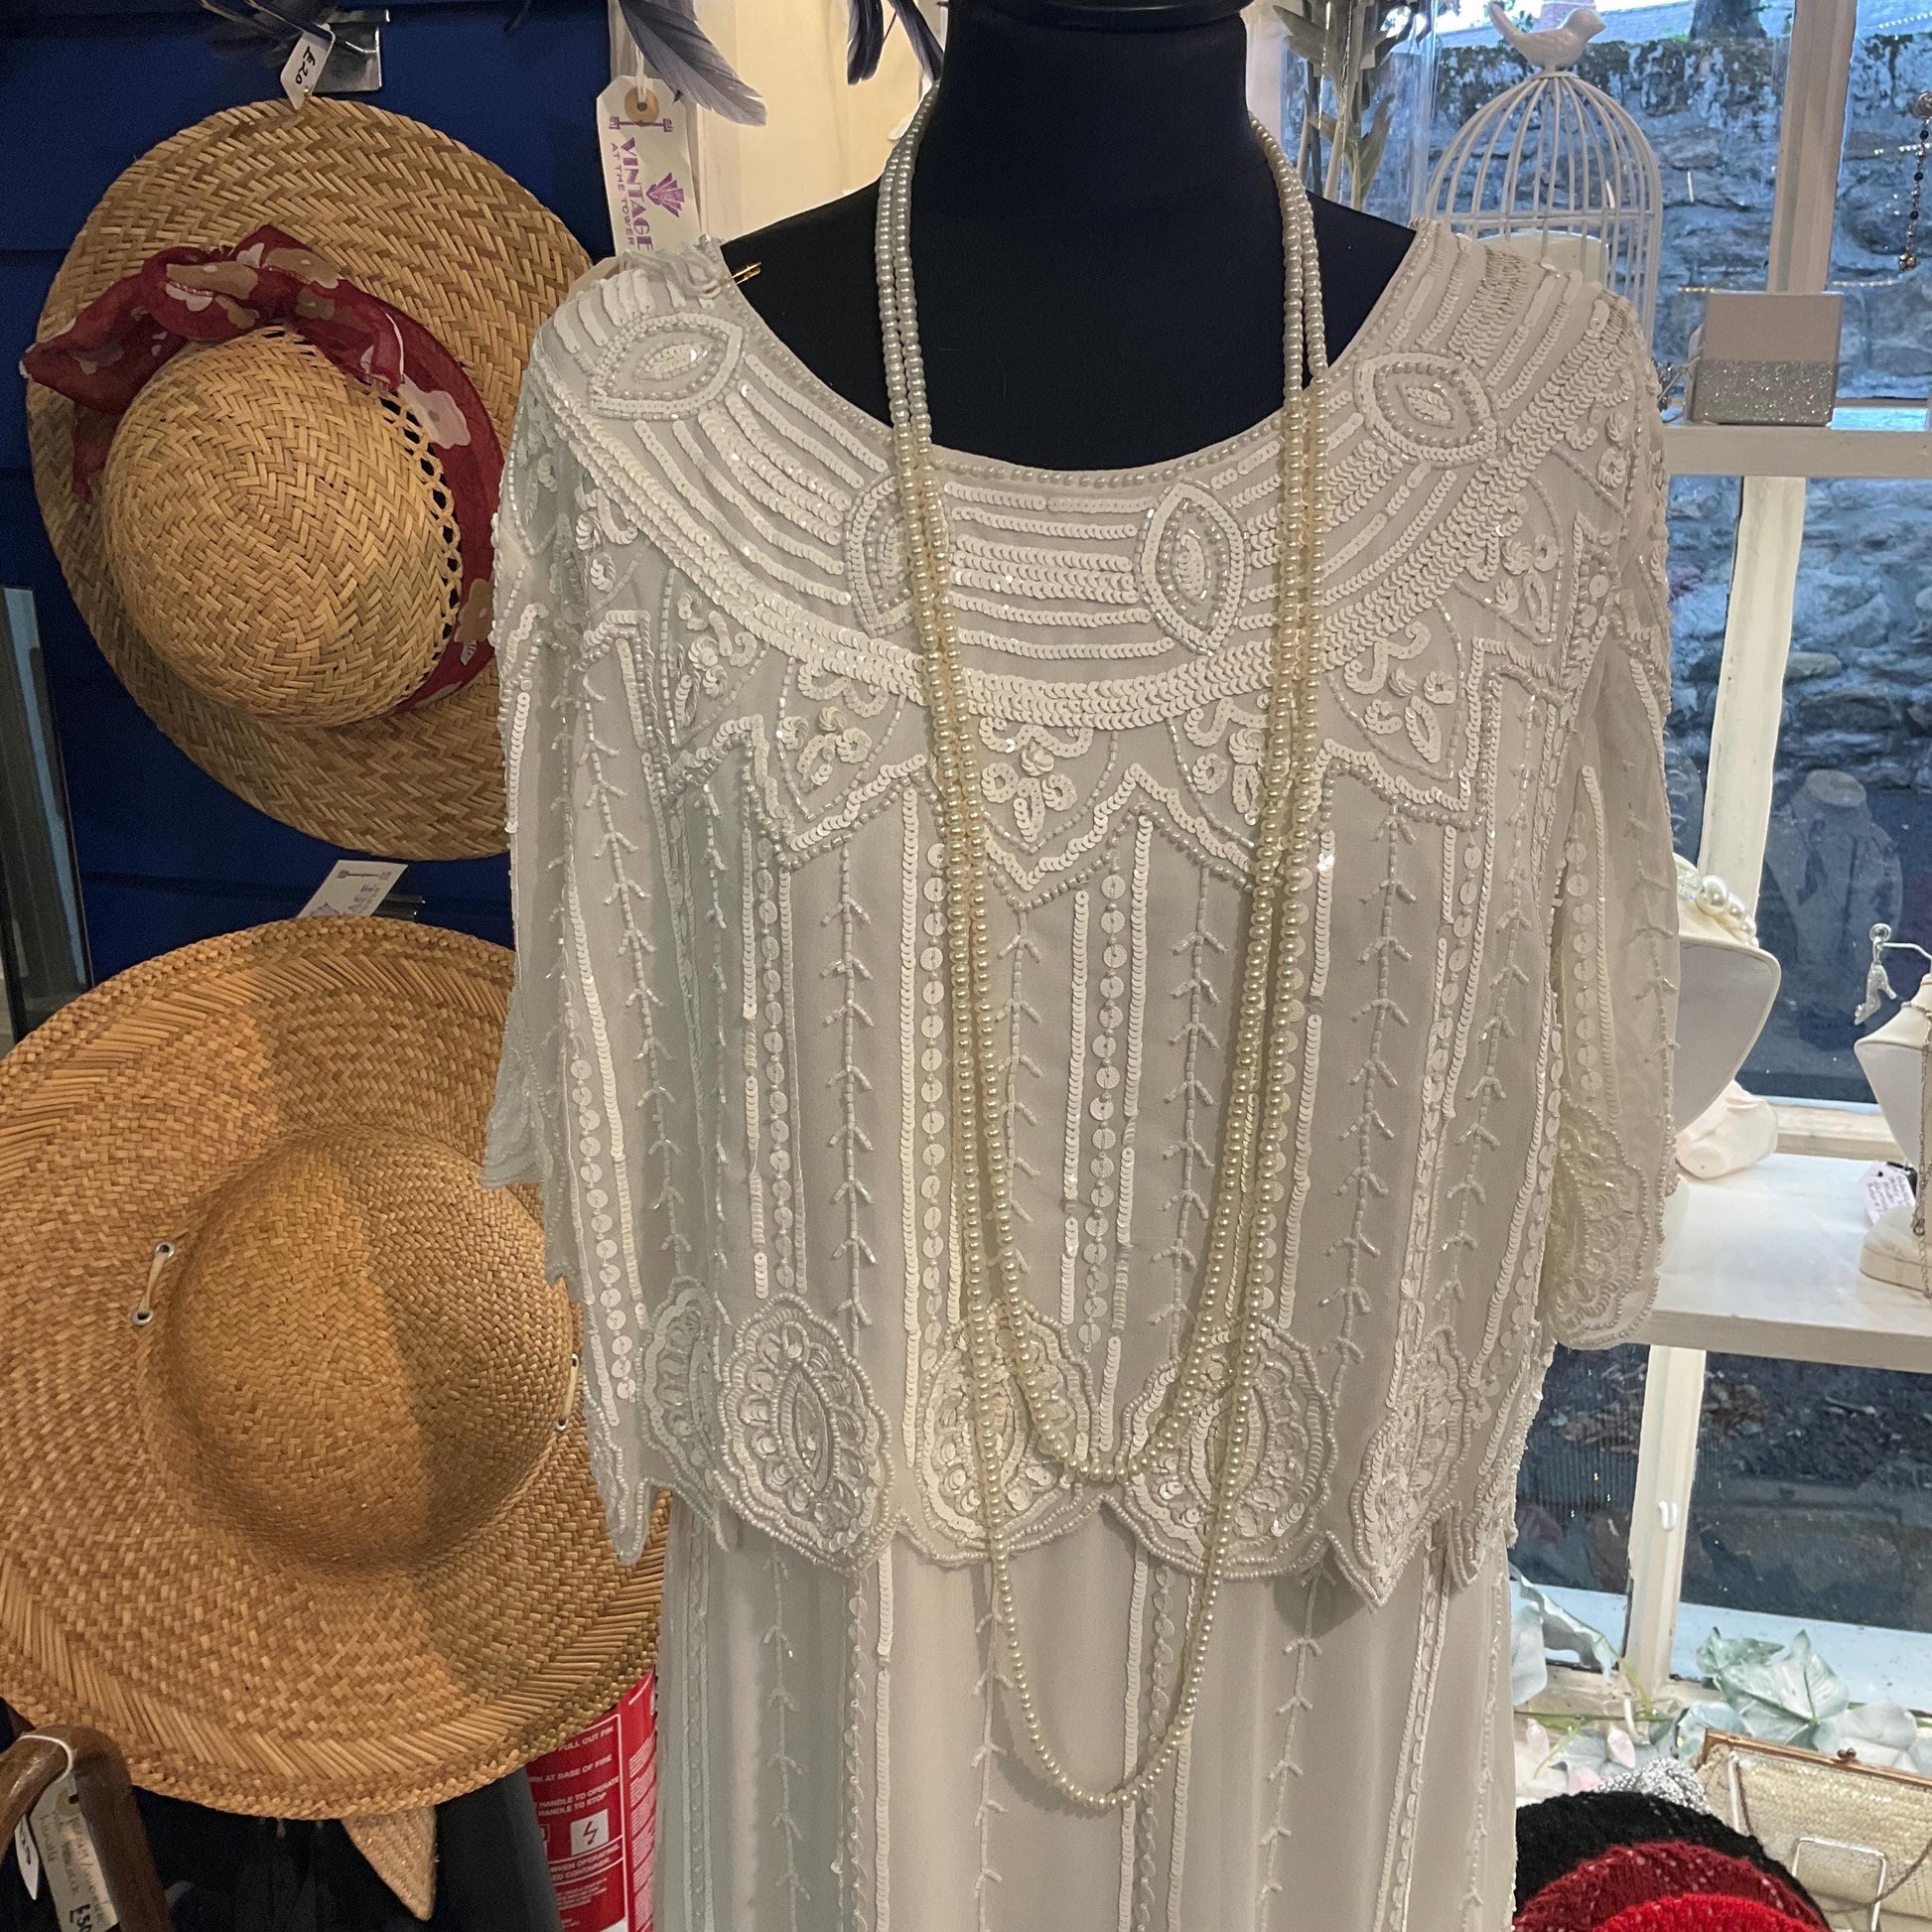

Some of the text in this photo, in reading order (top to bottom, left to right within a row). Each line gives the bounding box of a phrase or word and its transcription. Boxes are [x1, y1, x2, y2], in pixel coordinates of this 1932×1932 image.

[295, 46, 316, 84] £20
[611, 142, 635, 246] AT THE TOWER
[621, 137, 653, 251] VINTAGE
[582, 1732, 599, 1745] OUT
[557, 1768, 581, 1779] BASE
[582, 1763, 594, 1773] OF
[538, 1792, 607, 1816] HANDLE TO STOP
[539, 1796, 574, 1807] HANDLE
[587, 1775, 620, 1796] OPERATE
